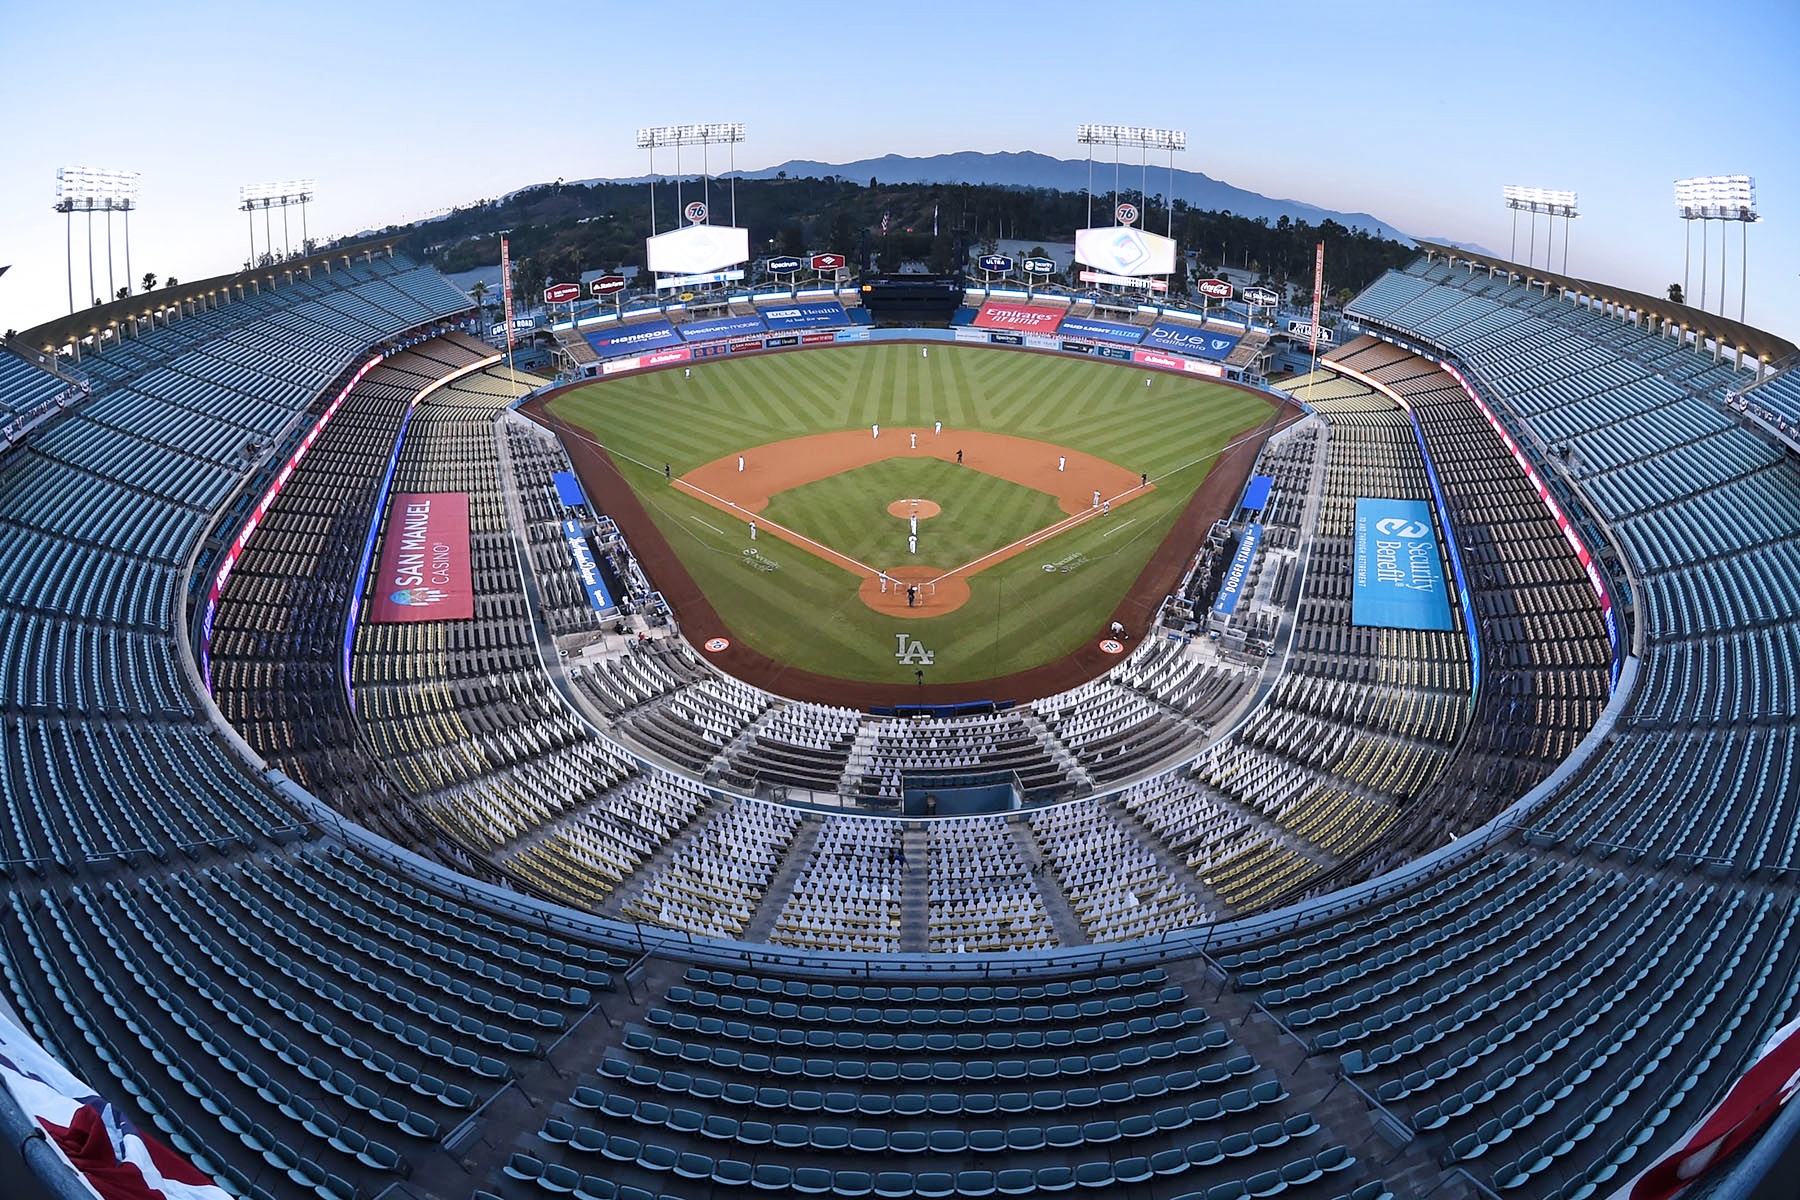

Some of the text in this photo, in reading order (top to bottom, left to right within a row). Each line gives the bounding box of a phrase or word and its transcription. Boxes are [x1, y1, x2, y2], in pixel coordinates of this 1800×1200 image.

[691, 206, 704, 217] 76
[1119, 208, 1134, 219] 76
[802, 307, 839, 315] Health
[986, 308, 1052, 320] Emirates
[516, 319, 533, 328] ROAD
[683, 321, 760, 336] Spectrum mobile
[1007, 317, 1040, 326] BETTER
[1110, 329, 1141, 338] SELTZER
[1151, 327, 1204, 345] blue
[1155, 338, 1206, 351] california
[394, 500, 431, 586] SAN MANUEL
[431, 544, 450, 585] CASINO
[1225, 563, 1245, 593] DODGER
[1241, 535, 1255, 563] STADIUM
[1376, 540, 1405, 583] Benefit
[1406, 542, 1438, 592] Security
[895, 634, 935, 665] LA
